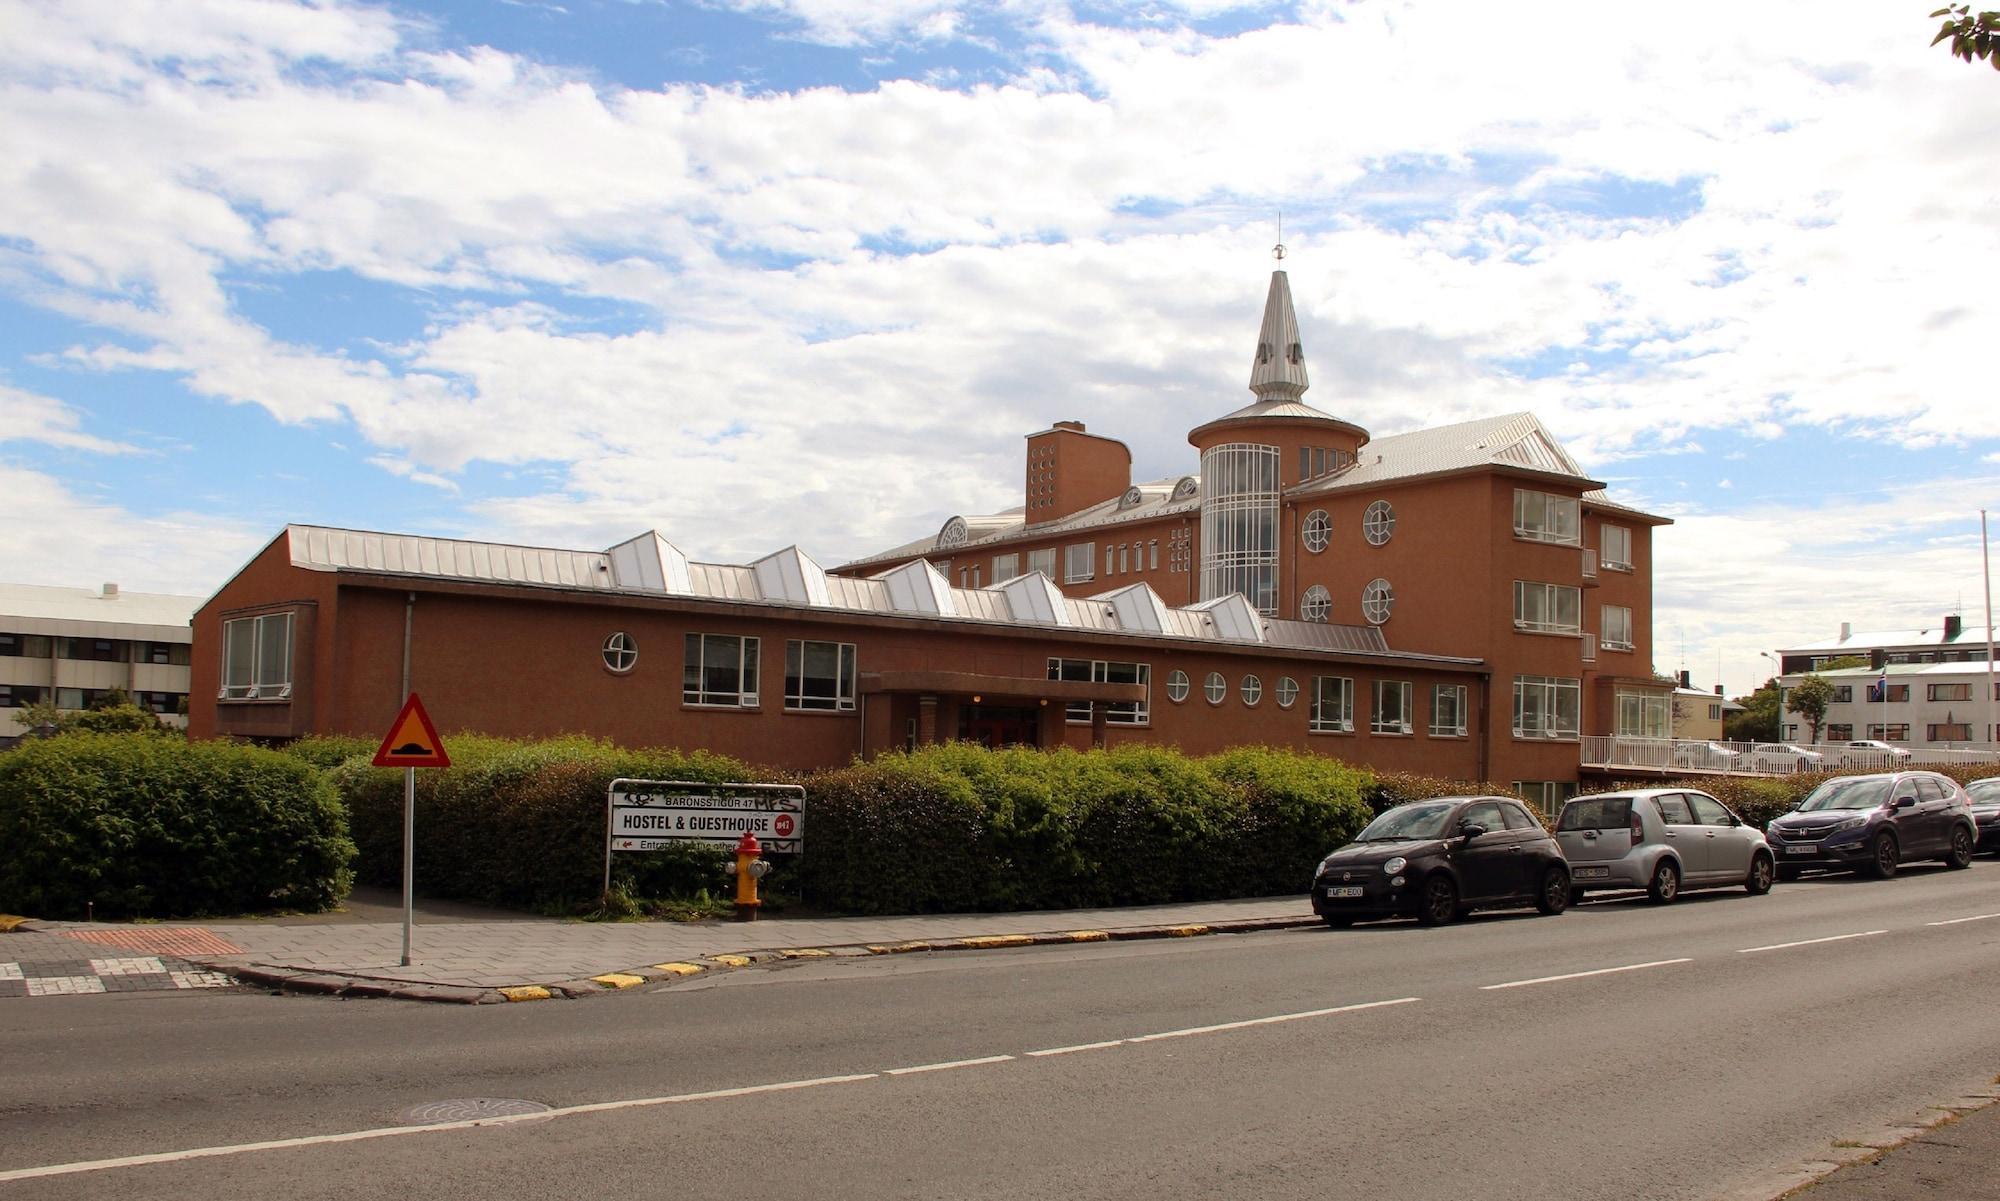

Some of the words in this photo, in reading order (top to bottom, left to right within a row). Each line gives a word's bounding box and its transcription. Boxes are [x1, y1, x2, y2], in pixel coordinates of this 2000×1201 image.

[742, 799, 754, 808] 47
[623, 815, 671, 829] HOSTEL
[676, 816, 685, 829] &
[689, 816, 769, 831] GUESTHOUSE
